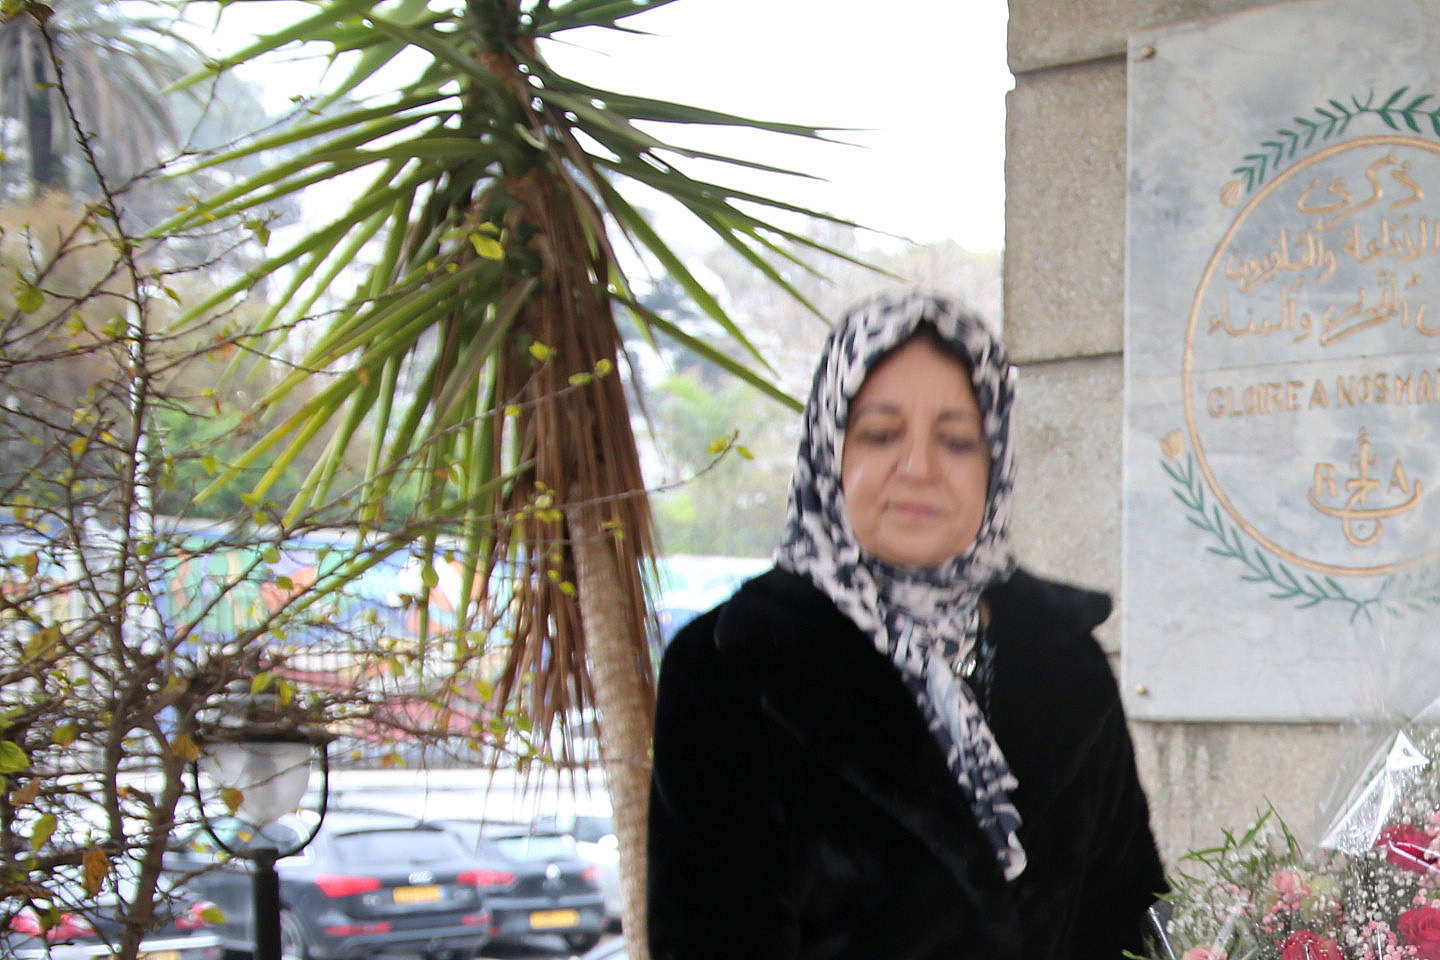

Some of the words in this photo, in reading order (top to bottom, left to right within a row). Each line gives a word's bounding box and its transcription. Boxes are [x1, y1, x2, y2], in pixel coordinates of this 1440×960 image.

[1297, 153, 1425, 233] ذكرى
[1206, 379, 1304, 419] GLOIRE
[1308, 378, 1329, 410] A
[1335, 372, 1390, 409] NOS
